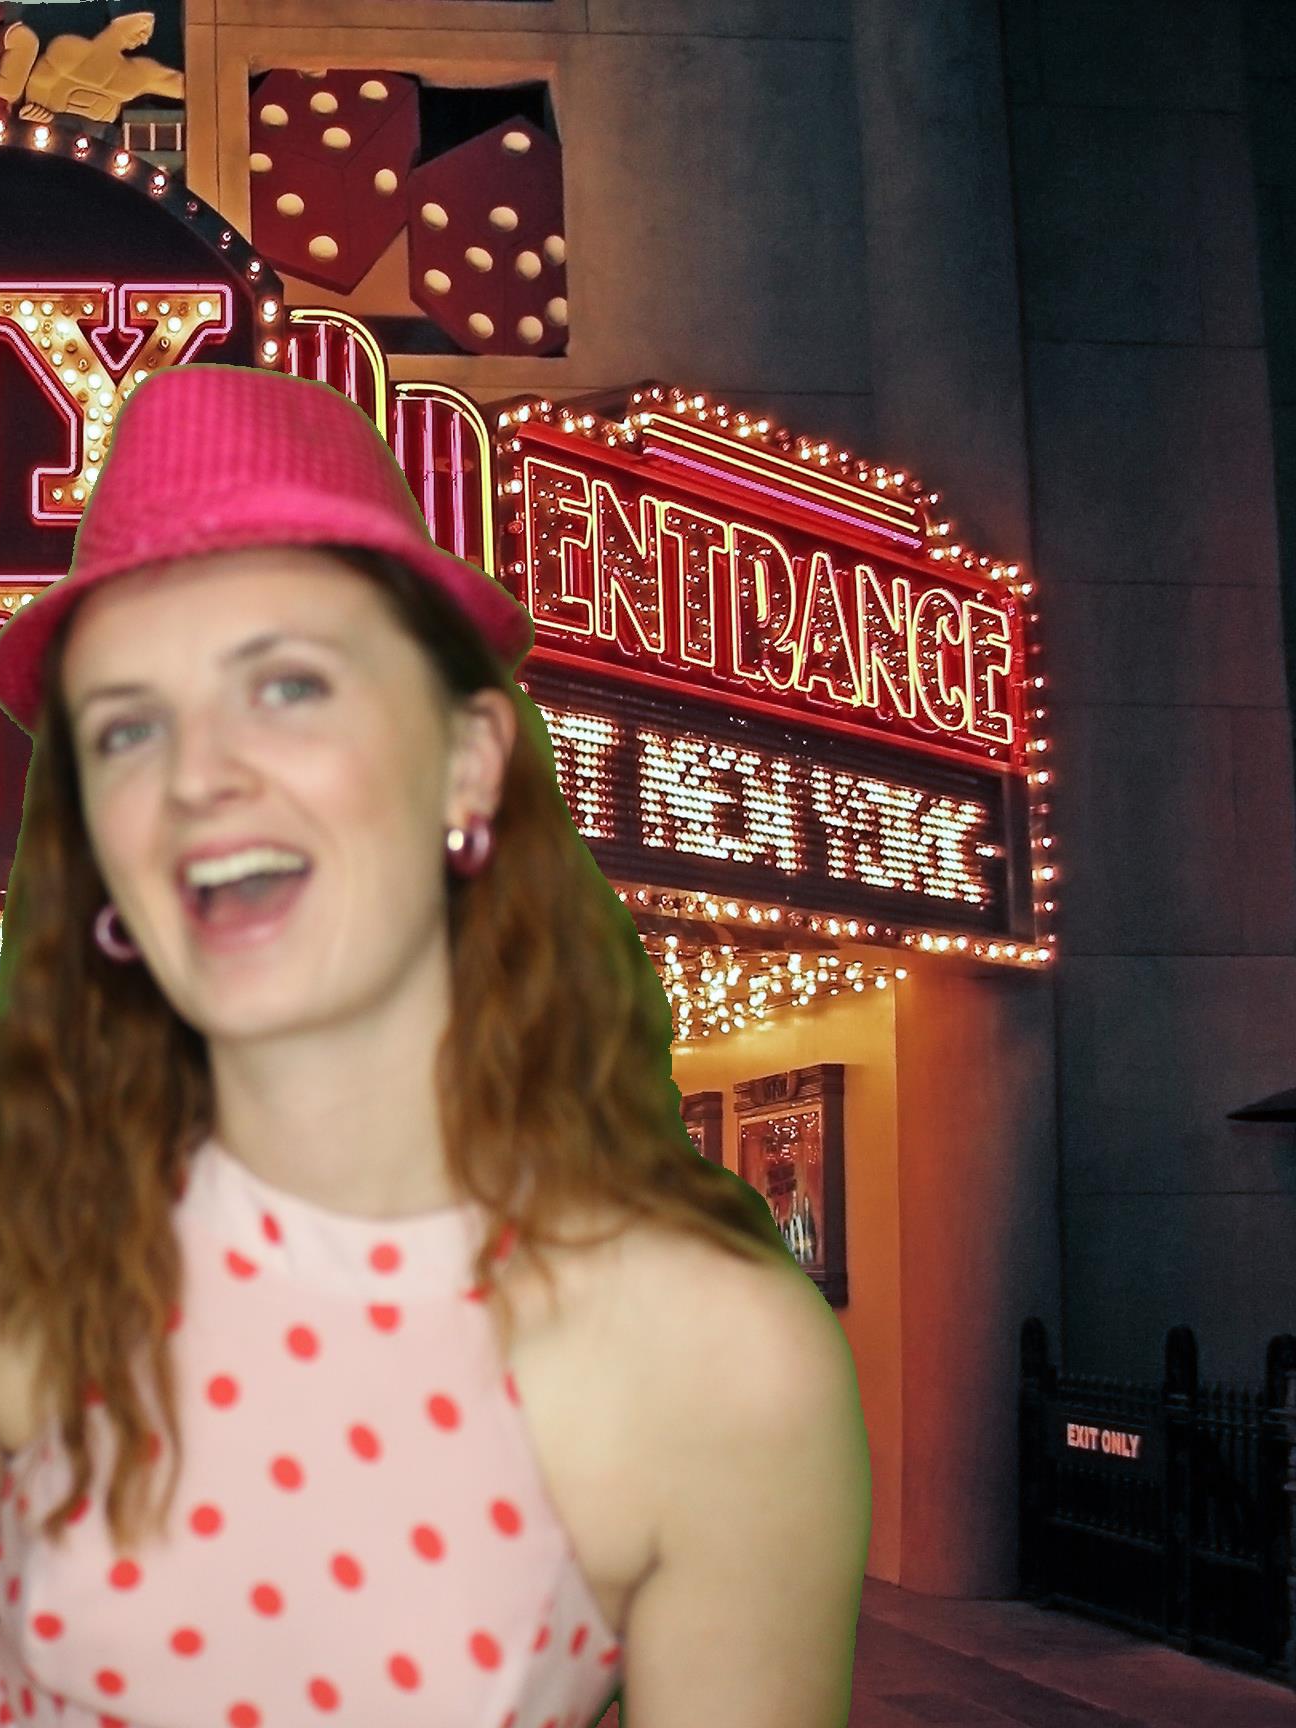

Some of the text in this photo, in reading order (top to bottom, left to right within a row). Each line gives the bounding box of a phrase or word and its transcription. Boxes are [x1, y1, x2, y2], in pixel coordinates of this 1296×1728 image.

[524, 456, 1014, 744] ENTRANCE
[1067, 1422, 1140, 1459] EXIT ONLY
